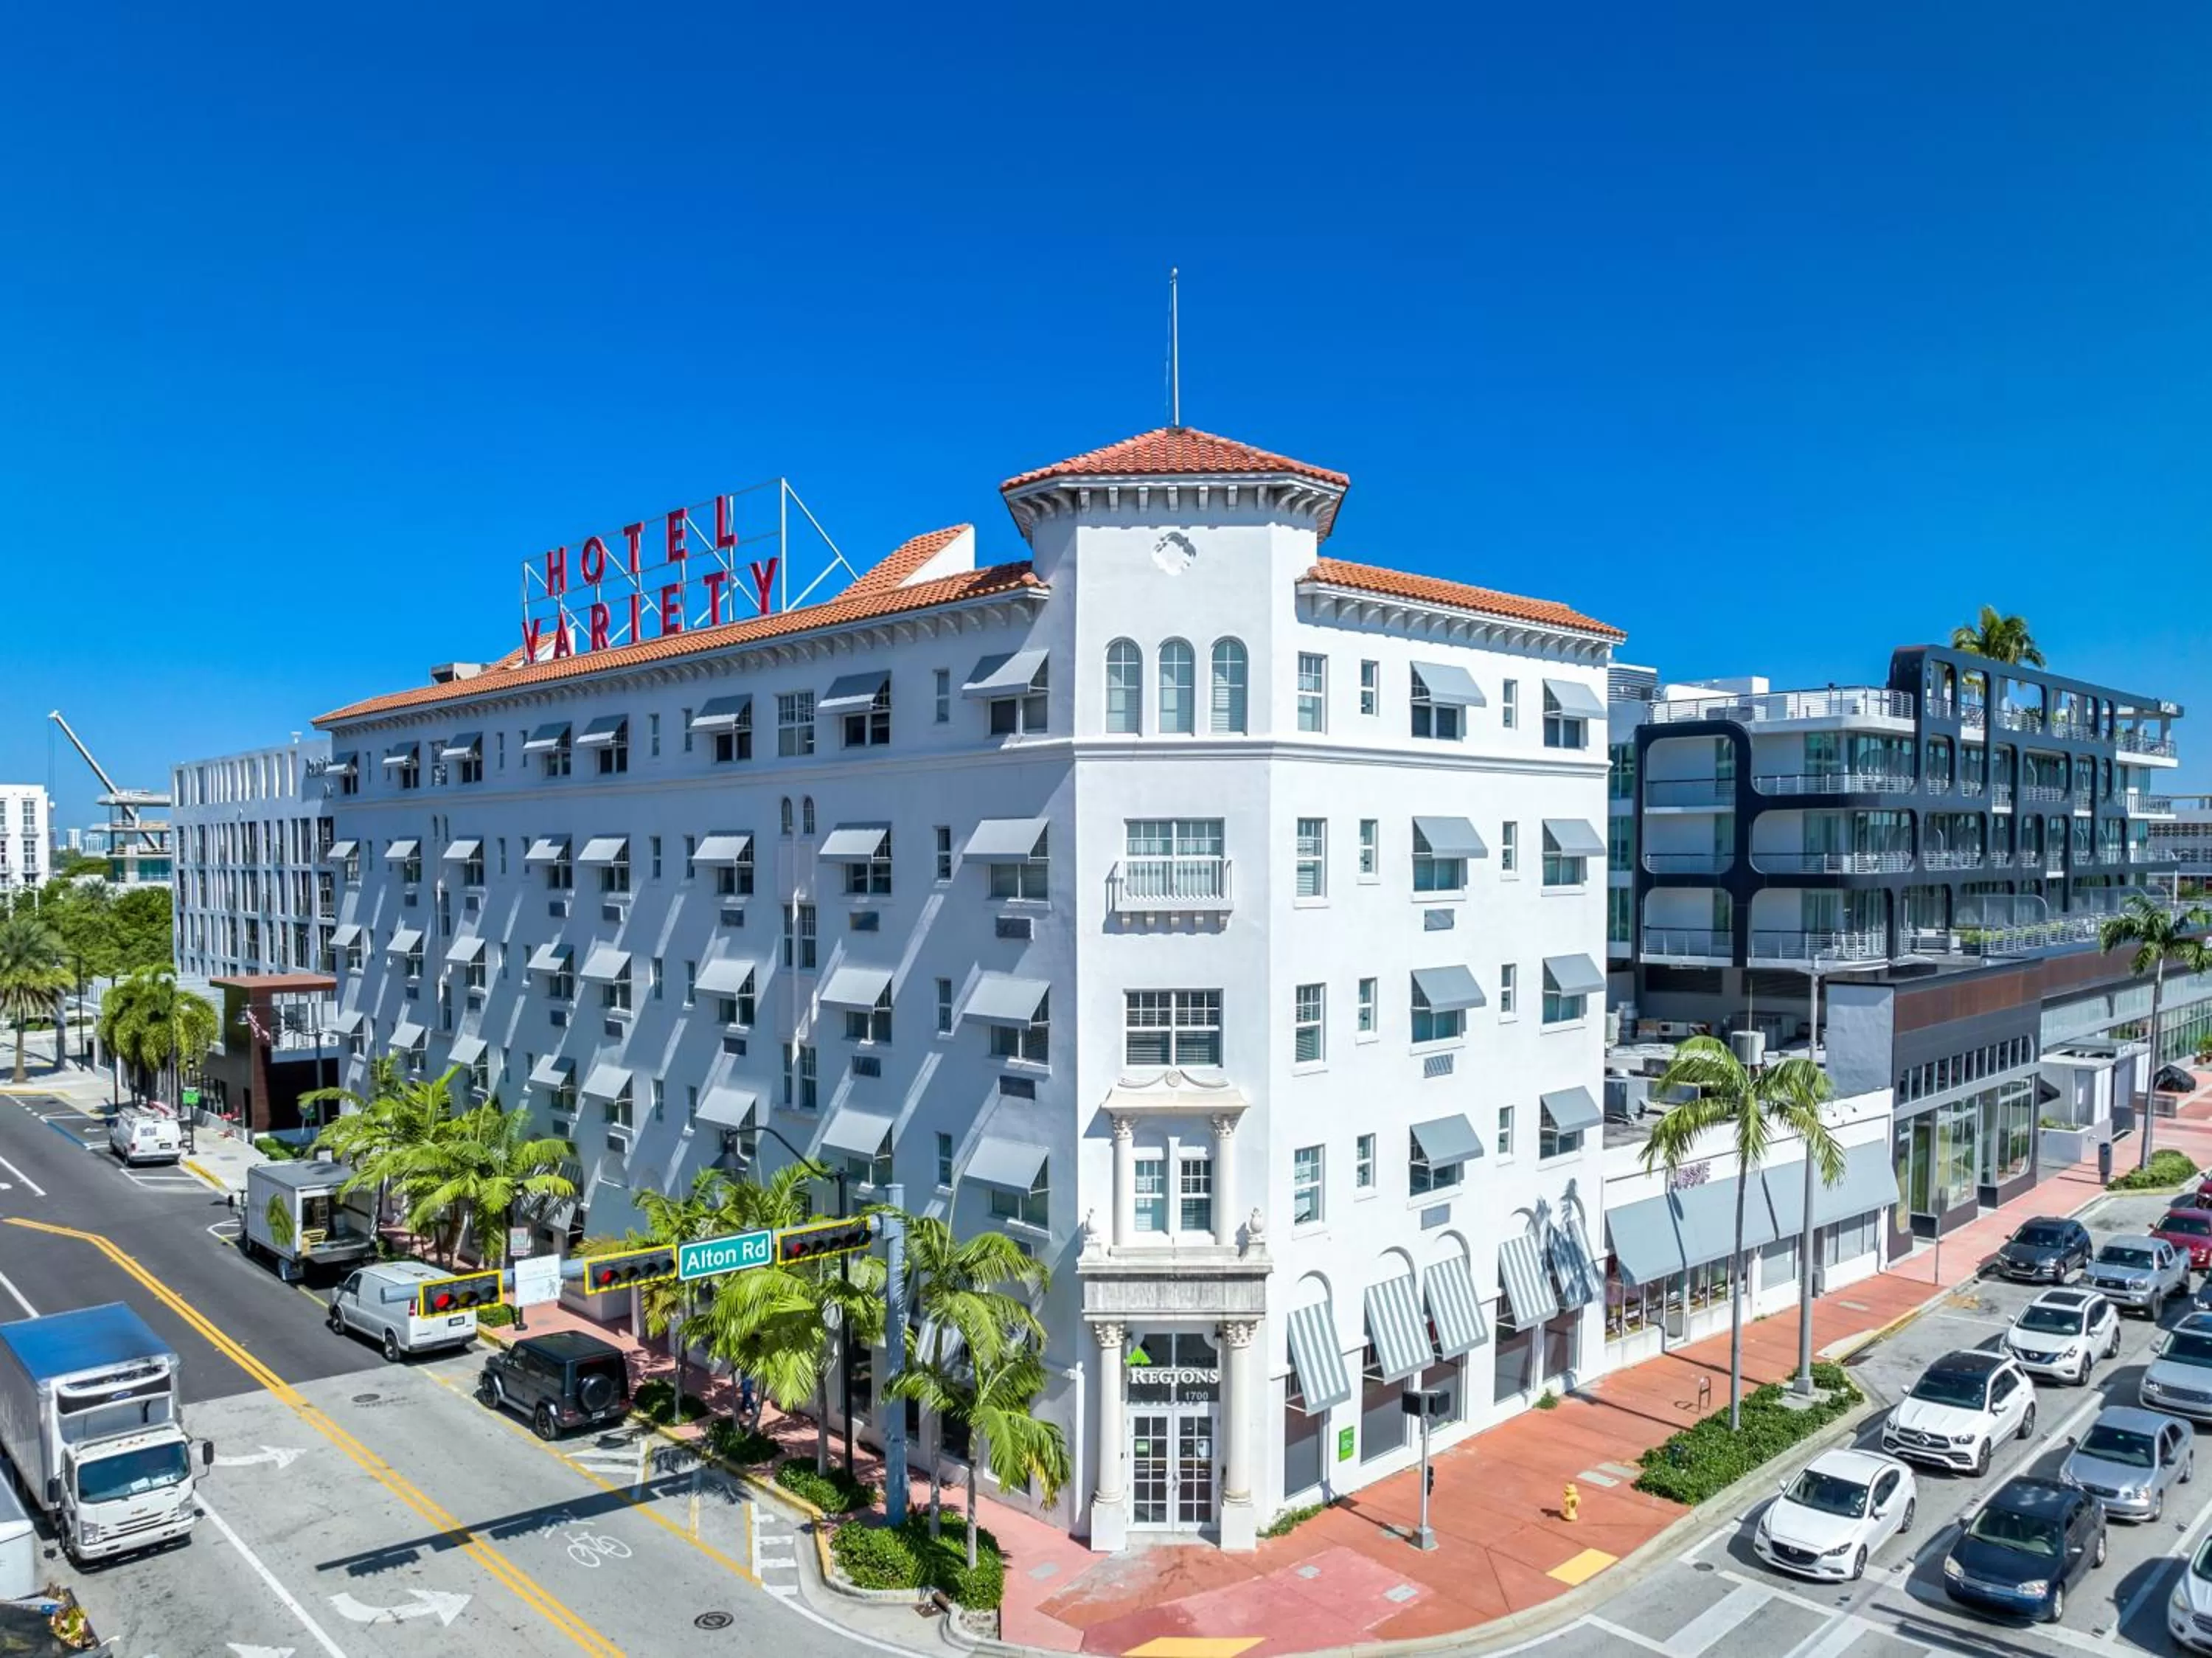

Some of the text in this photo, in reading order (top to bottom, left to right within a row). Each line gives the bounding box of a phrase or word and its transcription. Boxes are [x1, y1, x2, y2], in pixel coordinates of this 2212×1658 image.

[546, 496, 737, 597] HOTEL
[522, 558, 779, 663] VARIETY
[685, 1238, 766, 1272] Alton Rd
[1186, 1392, 1208, 1401] 1700
